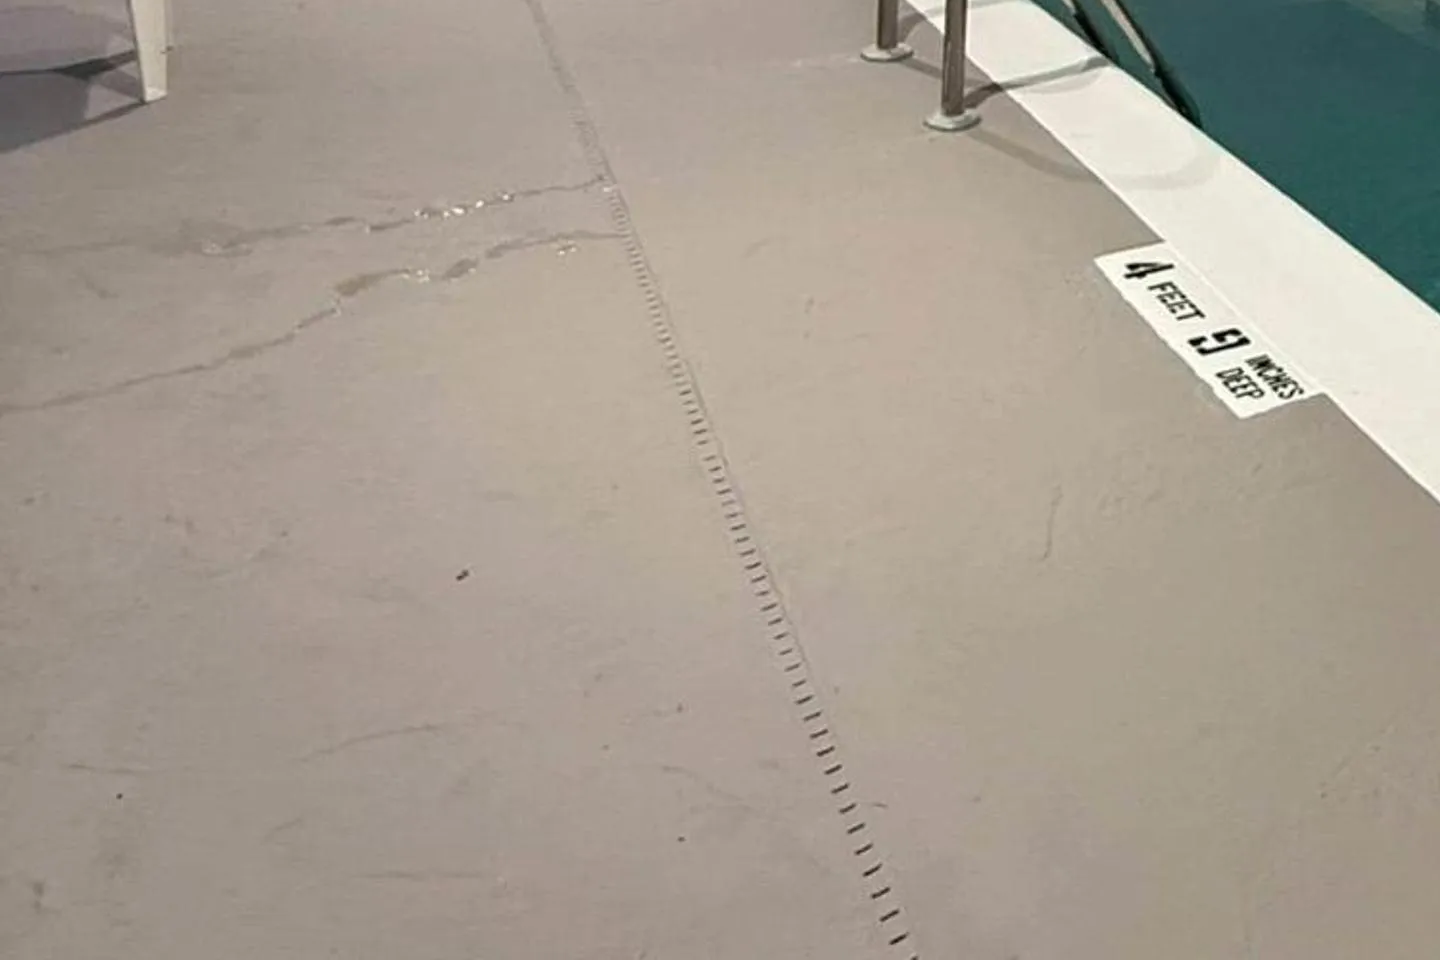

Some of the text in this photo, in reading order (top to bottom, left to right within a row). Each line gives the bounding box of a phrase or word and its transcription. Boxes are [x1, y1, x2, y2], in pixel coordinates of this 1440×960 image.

[1123, 261, 1305, 401] 4 FEET 9 INCHES
[1215, 366, 1266, 400] DEEP
